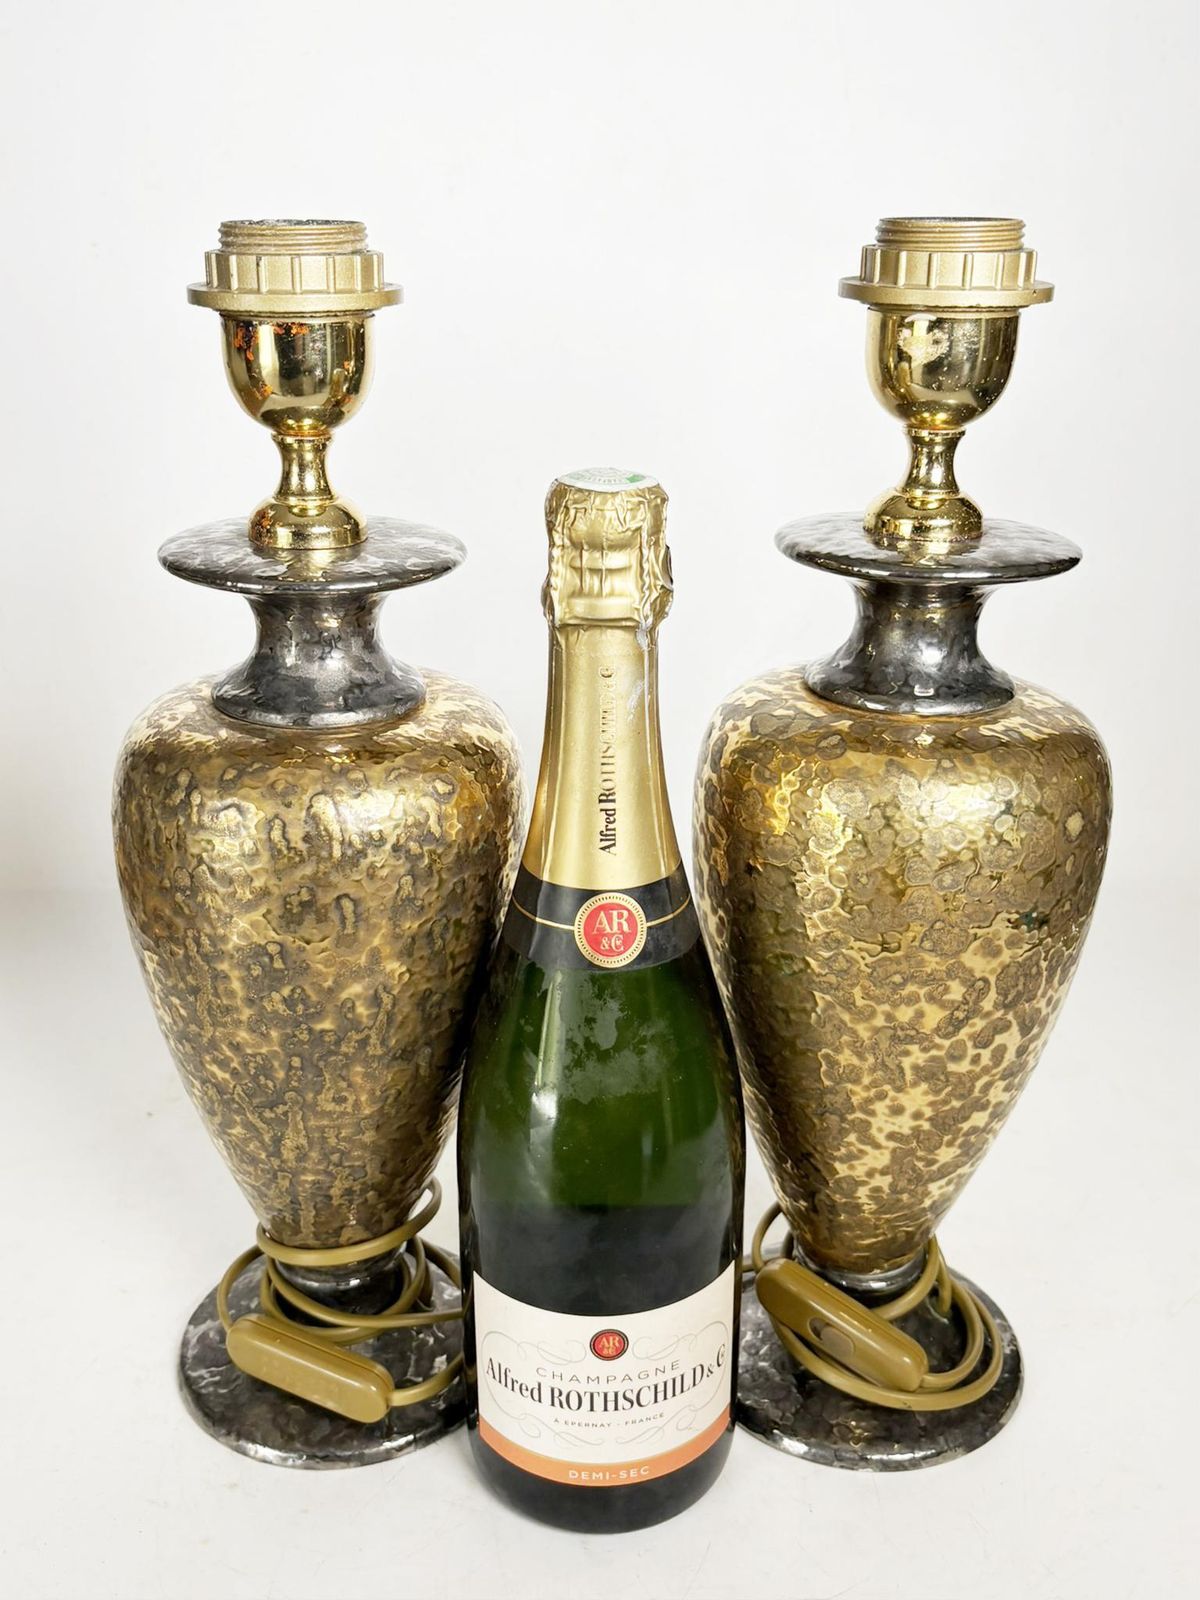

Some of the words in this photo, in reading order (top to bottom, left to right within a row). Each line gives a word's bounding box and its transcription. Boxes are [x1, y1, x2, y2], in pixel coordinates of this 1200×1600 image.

[598, 807, 617, 857] Alfred
[592, 909, 632, 935] AR
[599, 1335, 620, 1348] AR
[486, 1357, 543, 1404] Alfred
[549, 1362, 705, 1413] ROTHSCHILD
[536, 1359, 681, 1385] CHAMPAGNE
[624, 1412, 665, 1427] FRANCE
[568, 1466, 650, 1481] DEMI-SEC
